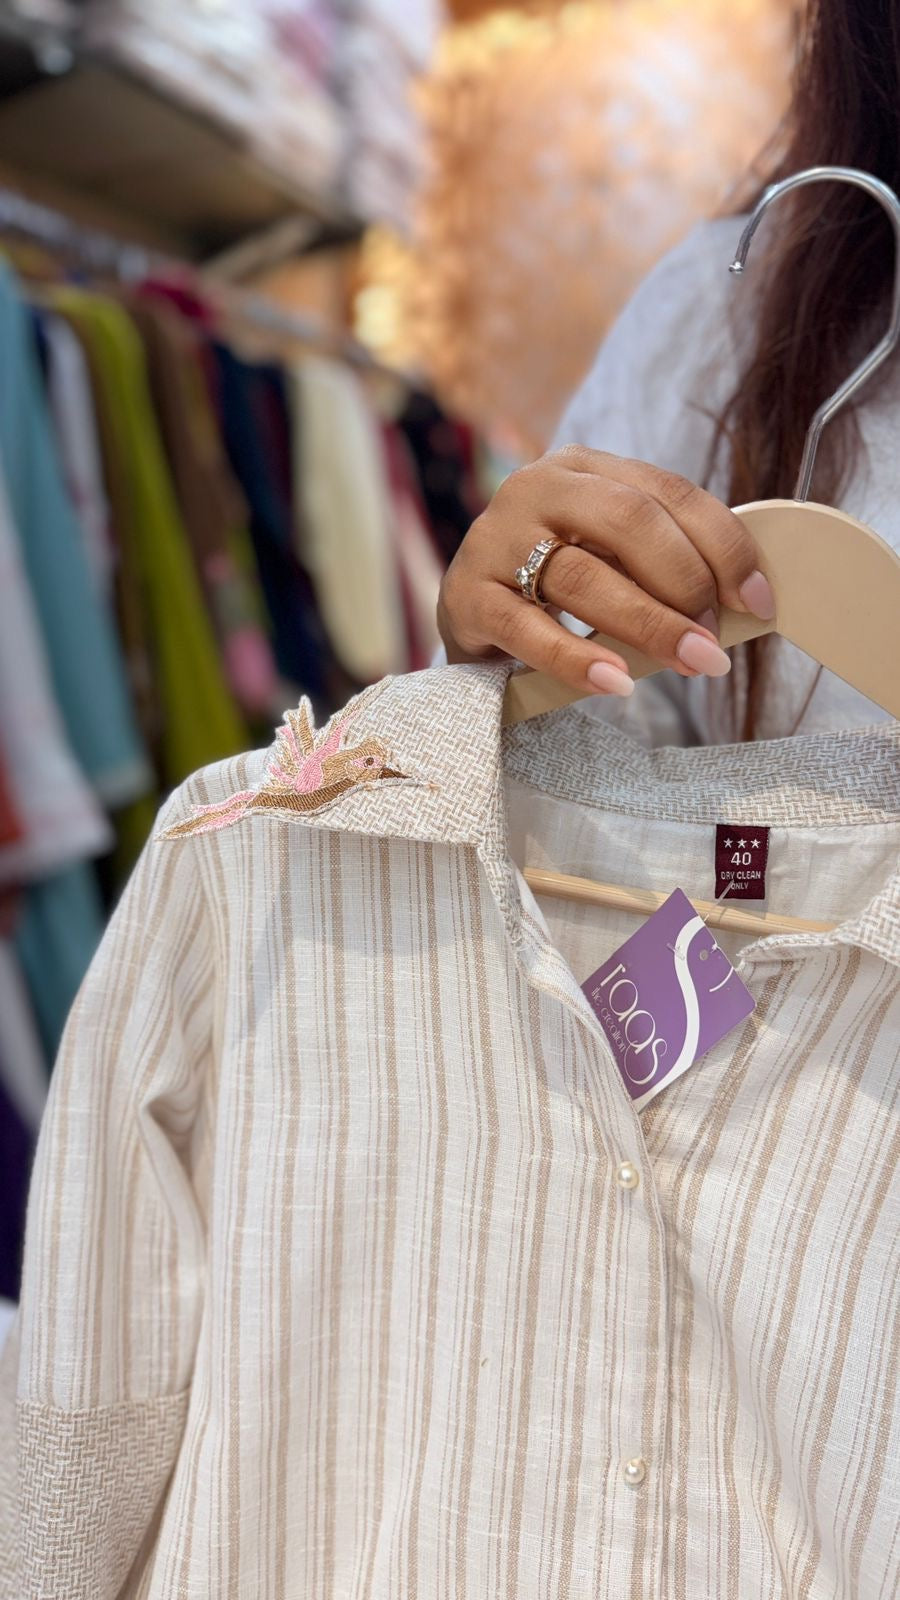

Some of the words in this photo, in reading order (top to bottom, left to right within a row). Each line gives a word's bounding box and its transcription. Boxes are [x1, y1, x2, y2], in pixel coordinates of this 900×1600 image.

[730, 852, 752, 866] 40
[720, 871, 735, 880] DRY
[736, 870, 762, 880] CLEAN
[730, 882, 749, 890] ONLY
